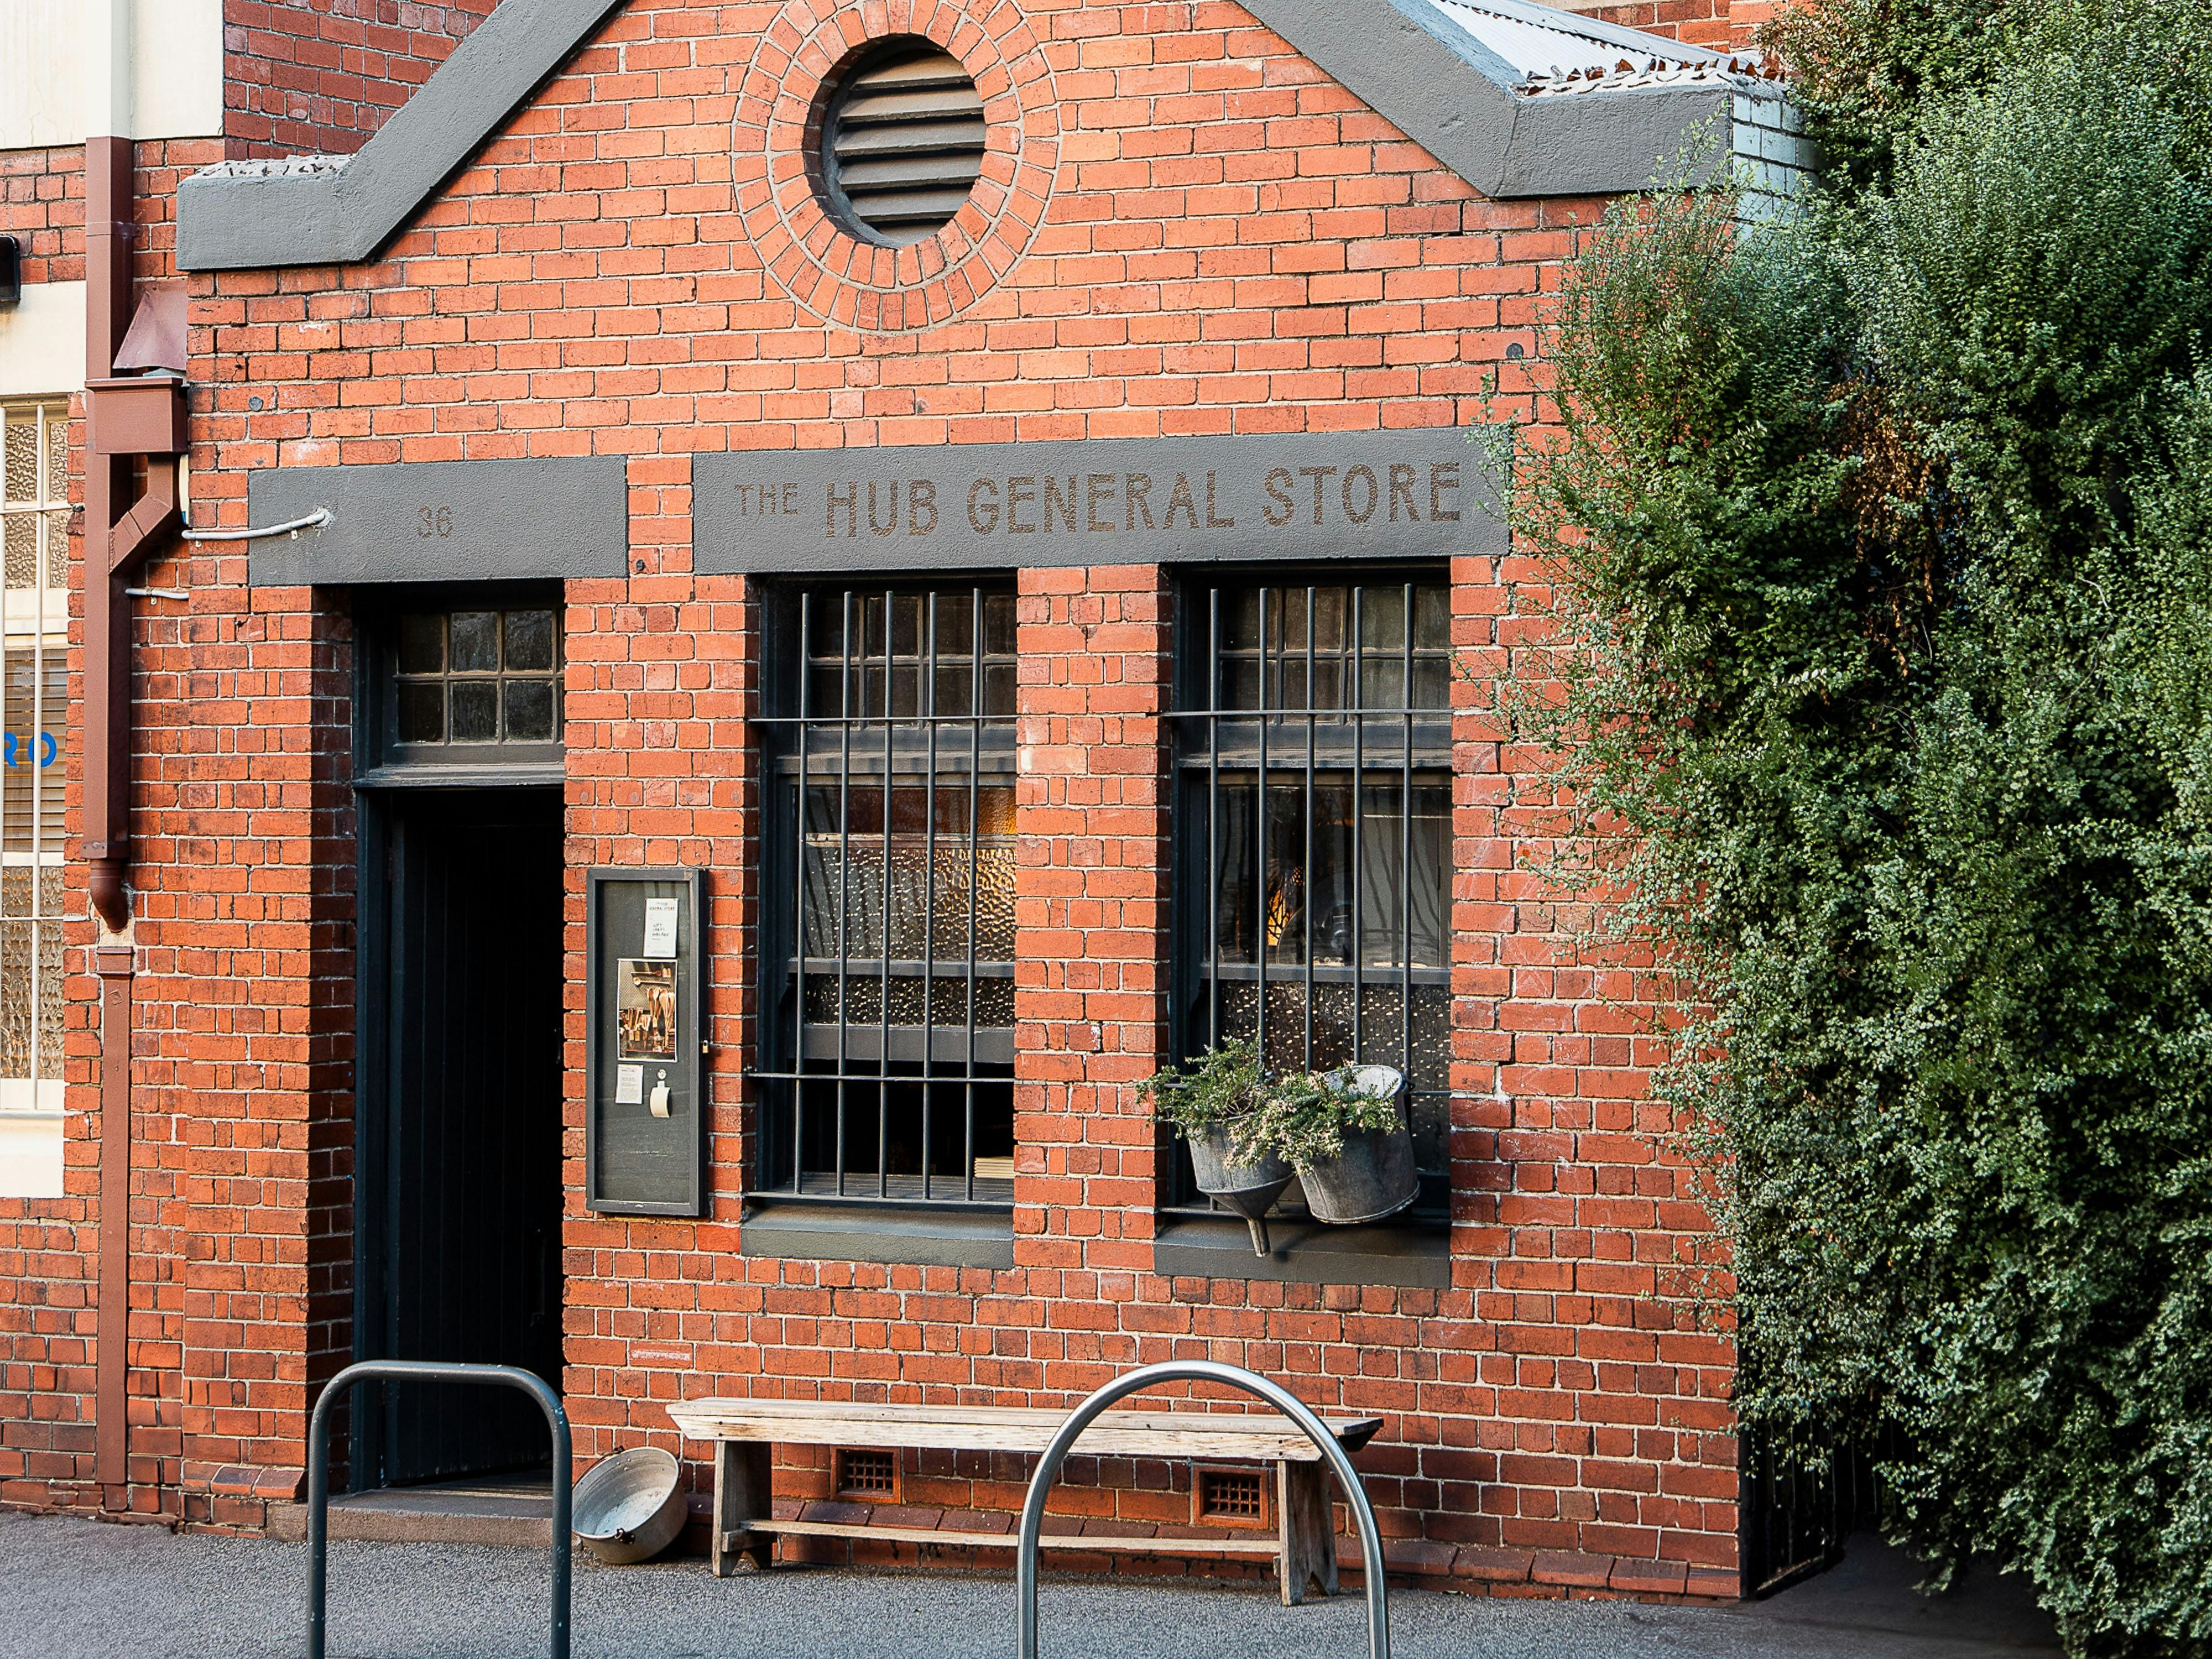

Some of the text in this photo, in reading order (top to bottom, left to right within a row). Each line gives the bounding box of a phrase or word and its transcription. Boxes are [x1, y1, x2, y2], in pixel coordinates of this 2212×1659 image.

[416, 504, 452, 539] 36
[734, 461, 1460, 538] THE HUB GENERAL STORE
